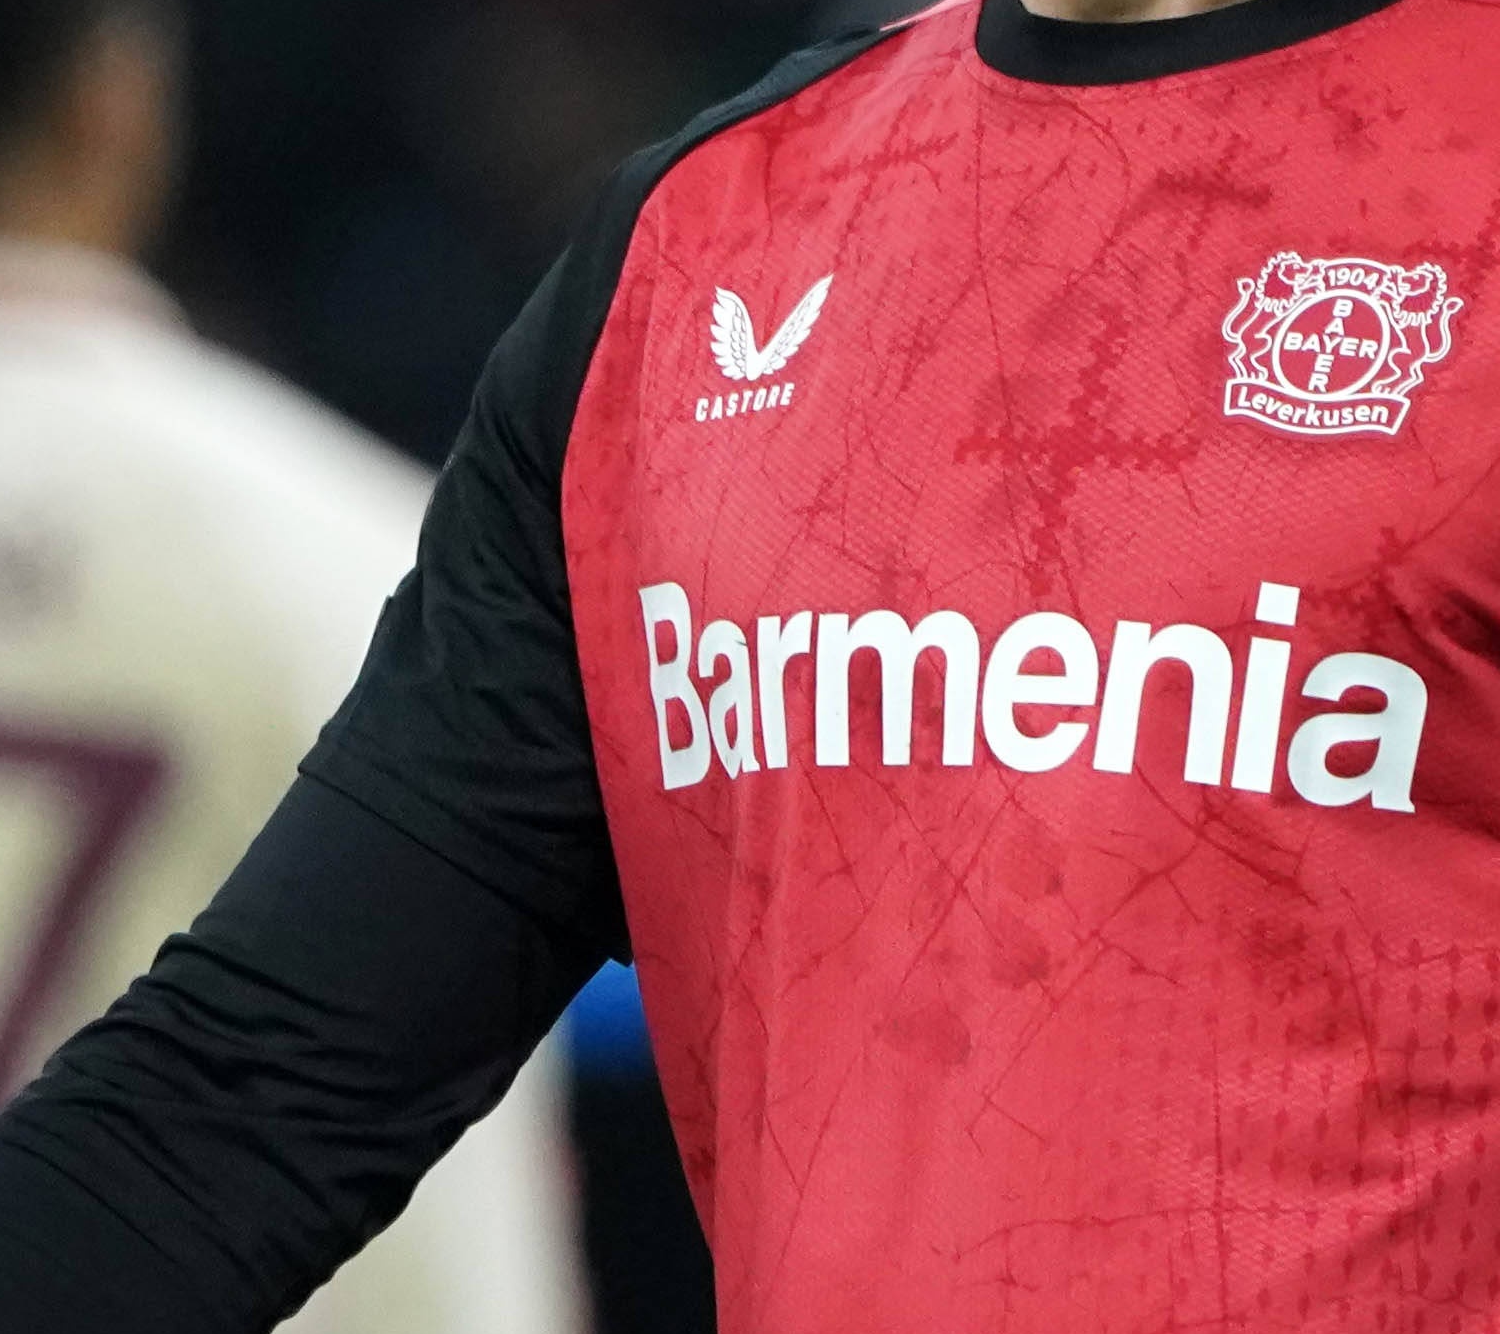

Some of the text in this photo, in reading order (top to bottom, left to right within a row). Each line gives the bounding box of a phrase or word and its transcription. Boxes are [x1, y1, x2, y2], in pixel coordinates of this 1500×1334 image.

[1327, 268, 1379, 290] 1904
[1283, 332, 1379, 359] BAYER
[1308, 298, 1353, 393] BAYER
[695, 383, 795, 422] CASTORE
[1237, 386, 1389, 427] Leverkusen
[638, 581, 1428, 813] Barmenia
